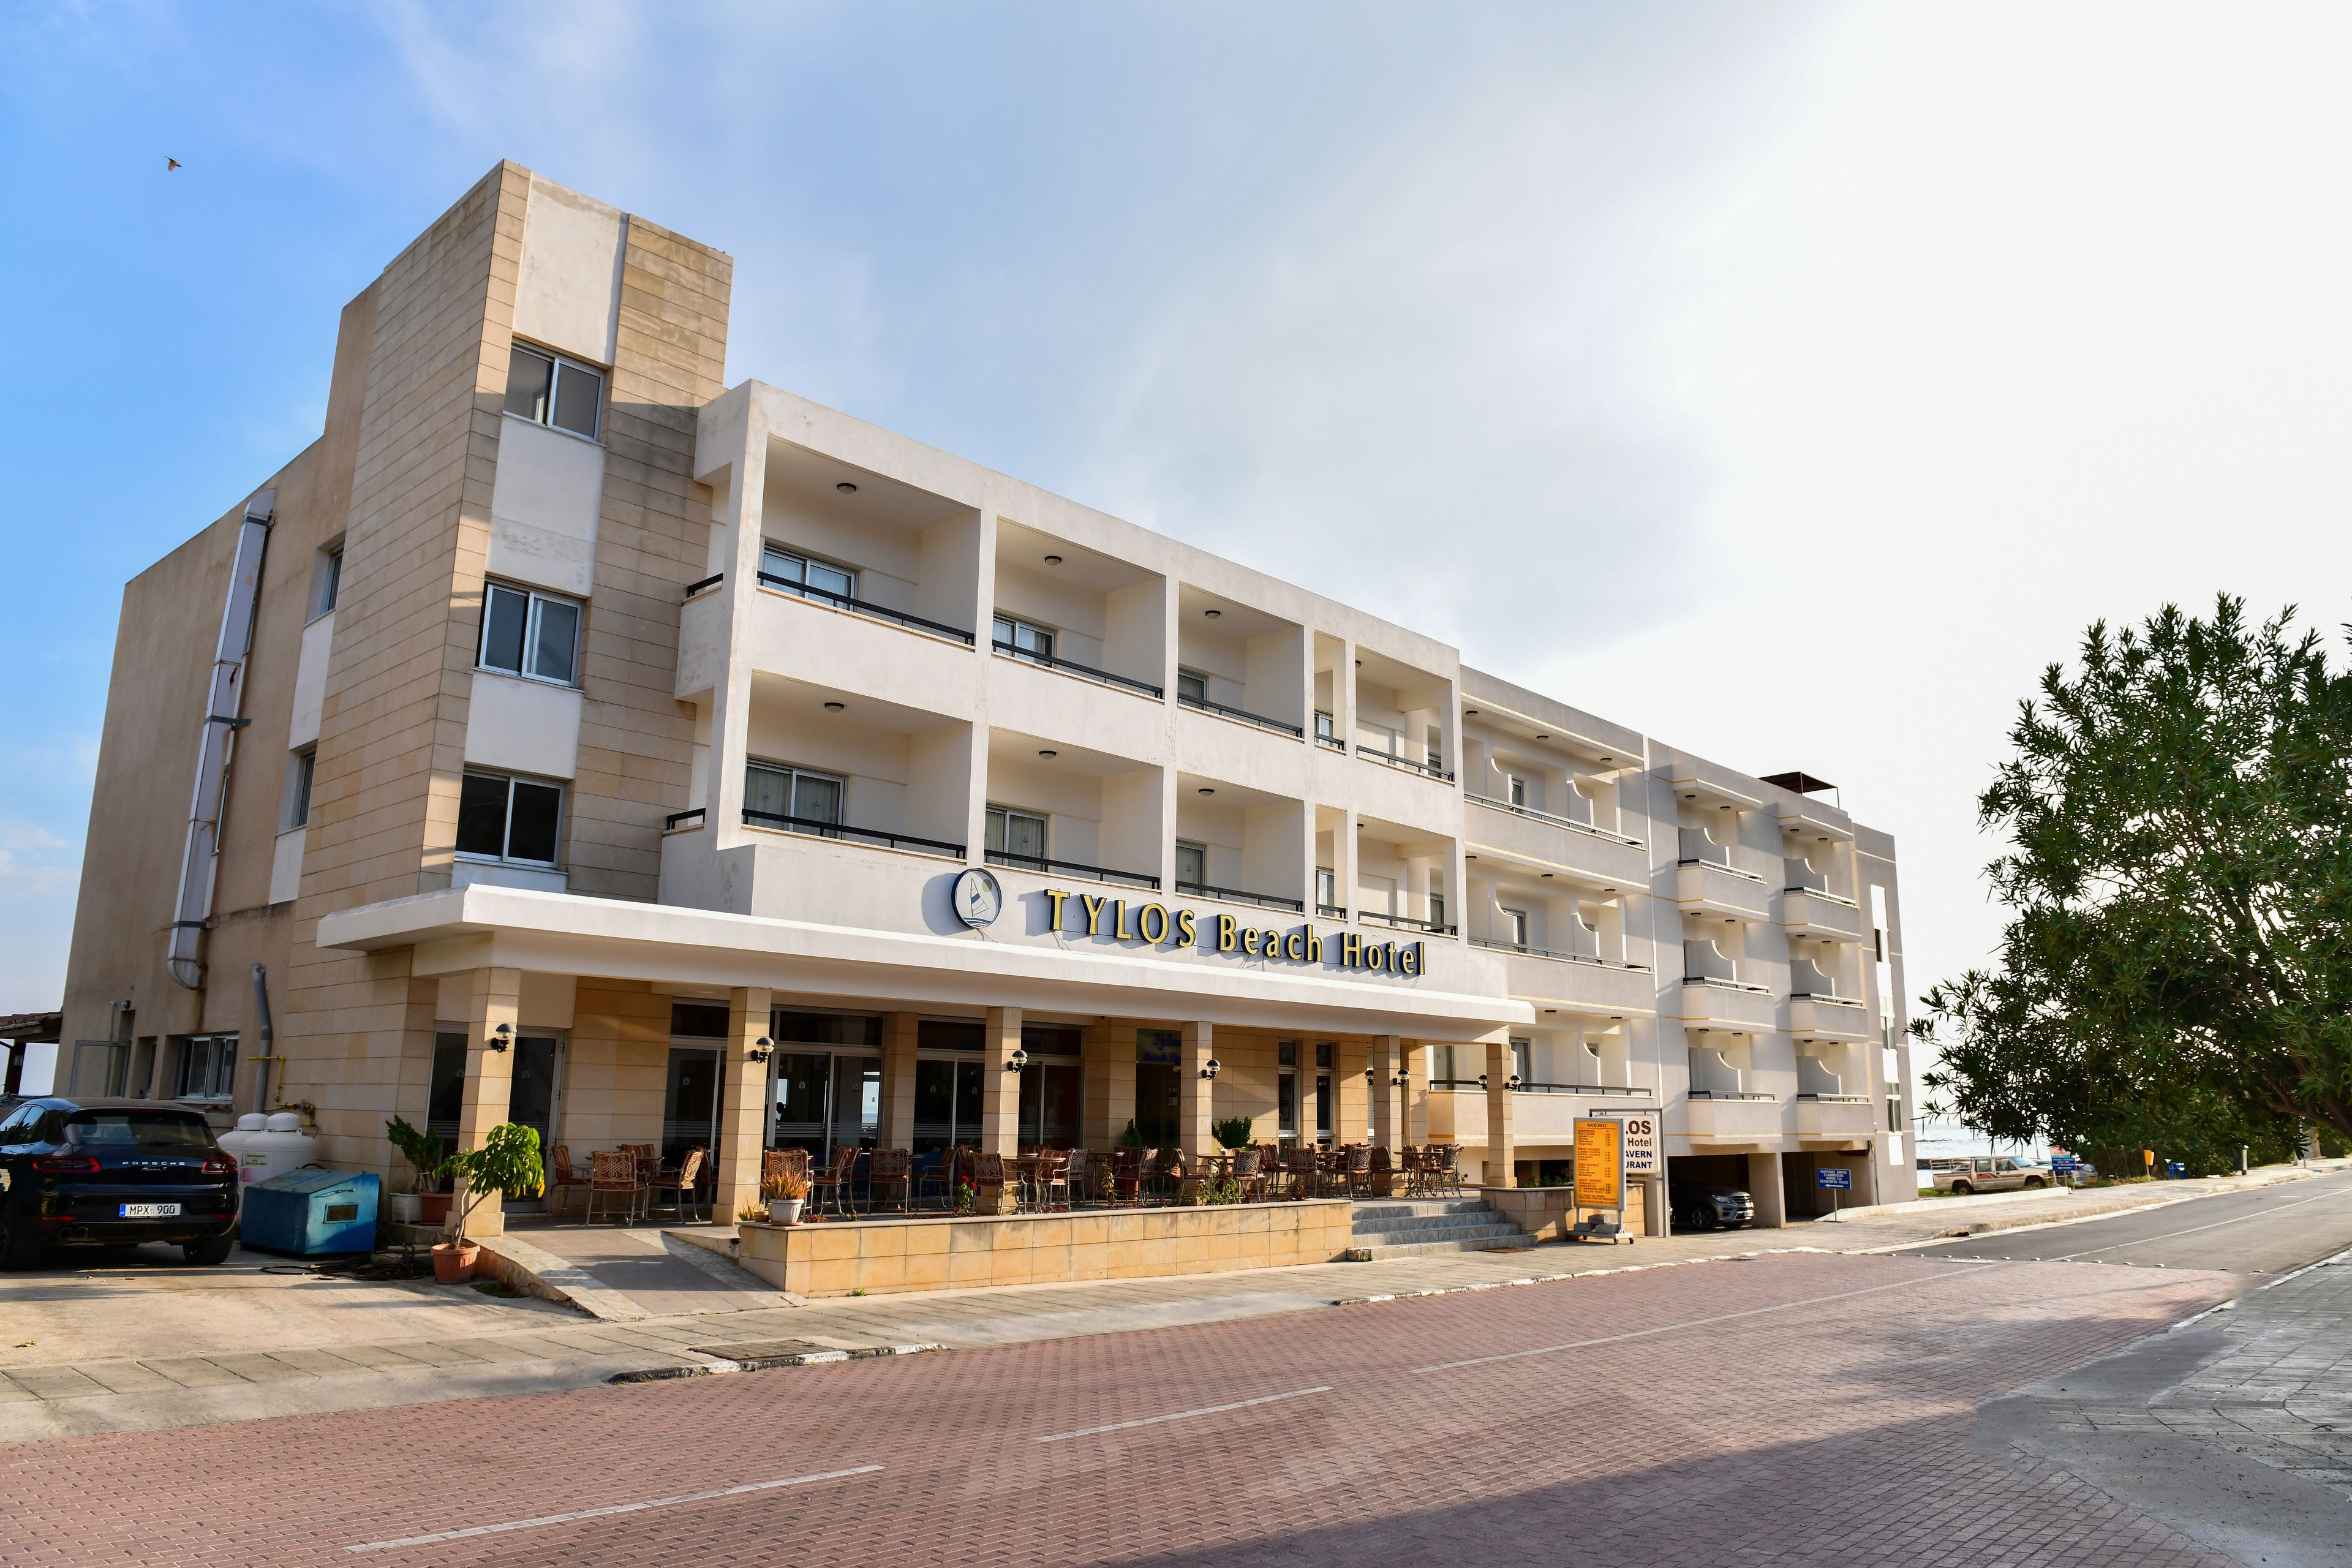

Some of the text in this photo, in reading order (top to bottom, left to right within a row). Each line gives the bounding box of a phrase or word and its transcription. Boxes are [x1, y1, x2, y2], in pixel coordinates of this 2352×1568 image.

[1044, 889, 1425, 975] TYLOS Beach Hotel
[1626, 1120, 1651, 1135] OS
[1627, 1137, 1652, 1147] Hotel
[129, 1205, 176, 1215] MPX 900
